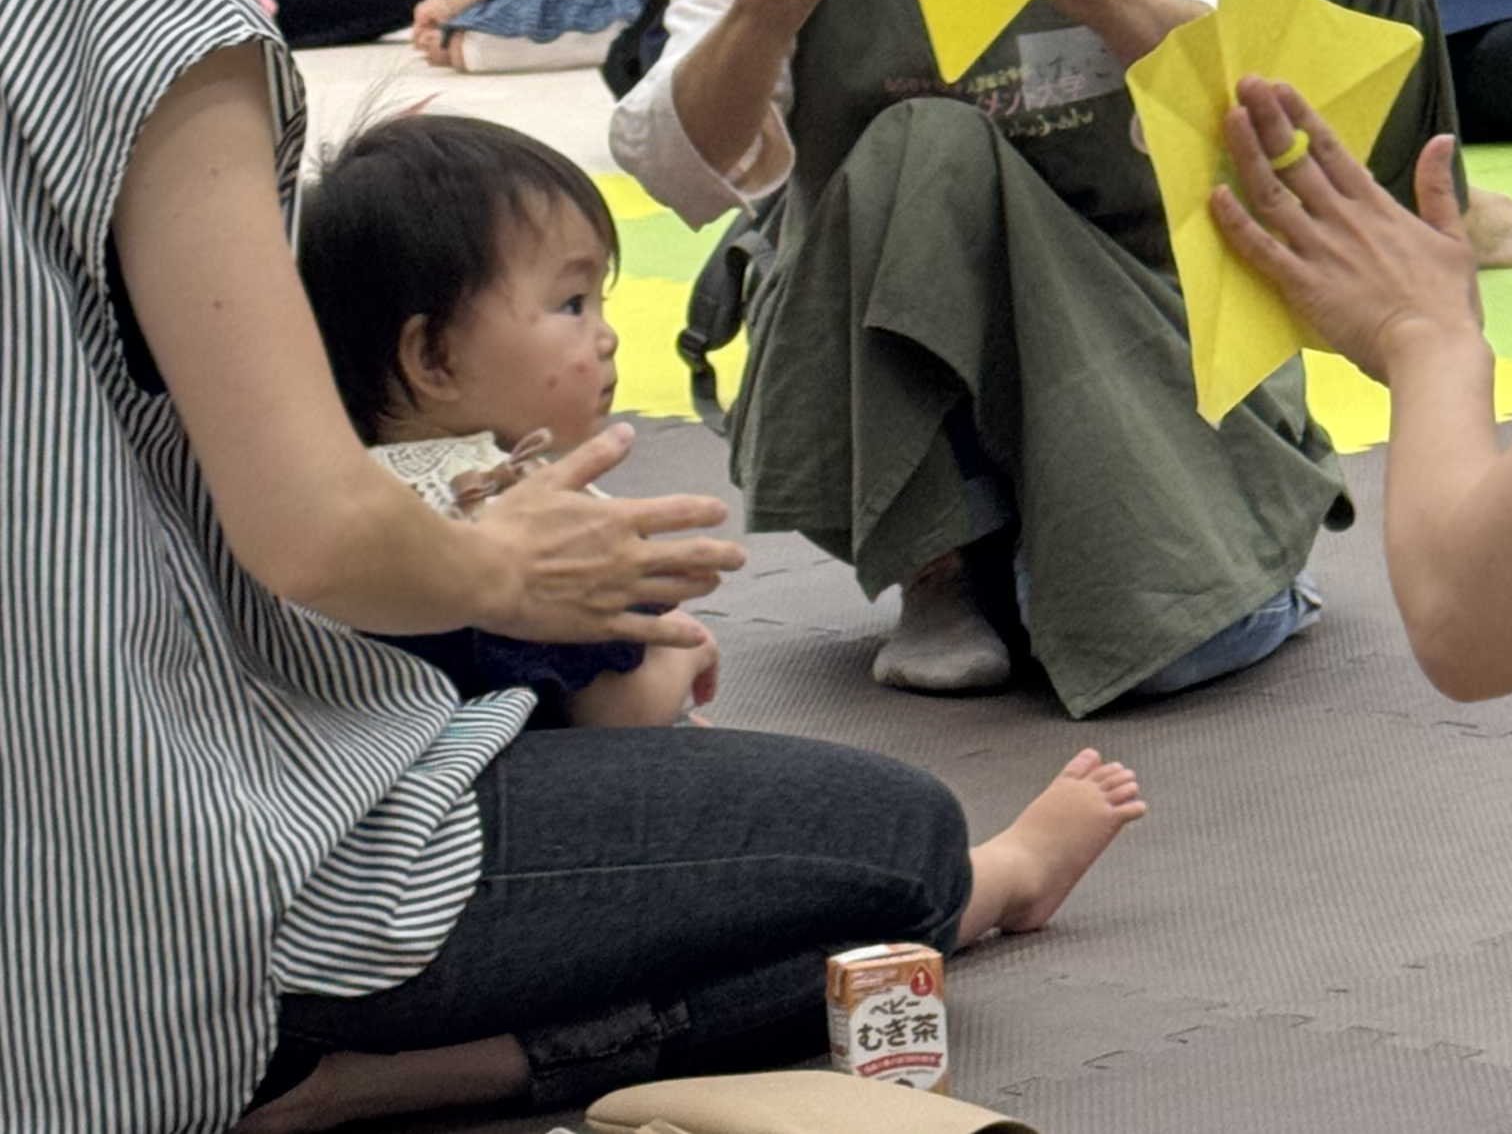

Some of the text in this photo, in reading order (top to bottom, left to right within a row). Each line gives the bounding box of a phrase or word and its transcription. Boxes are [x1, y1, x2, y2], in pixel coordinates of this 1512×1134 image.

[869, 995, 922, 1016] ベビー
[856, 1012, 940, 1052] むぎ茶
